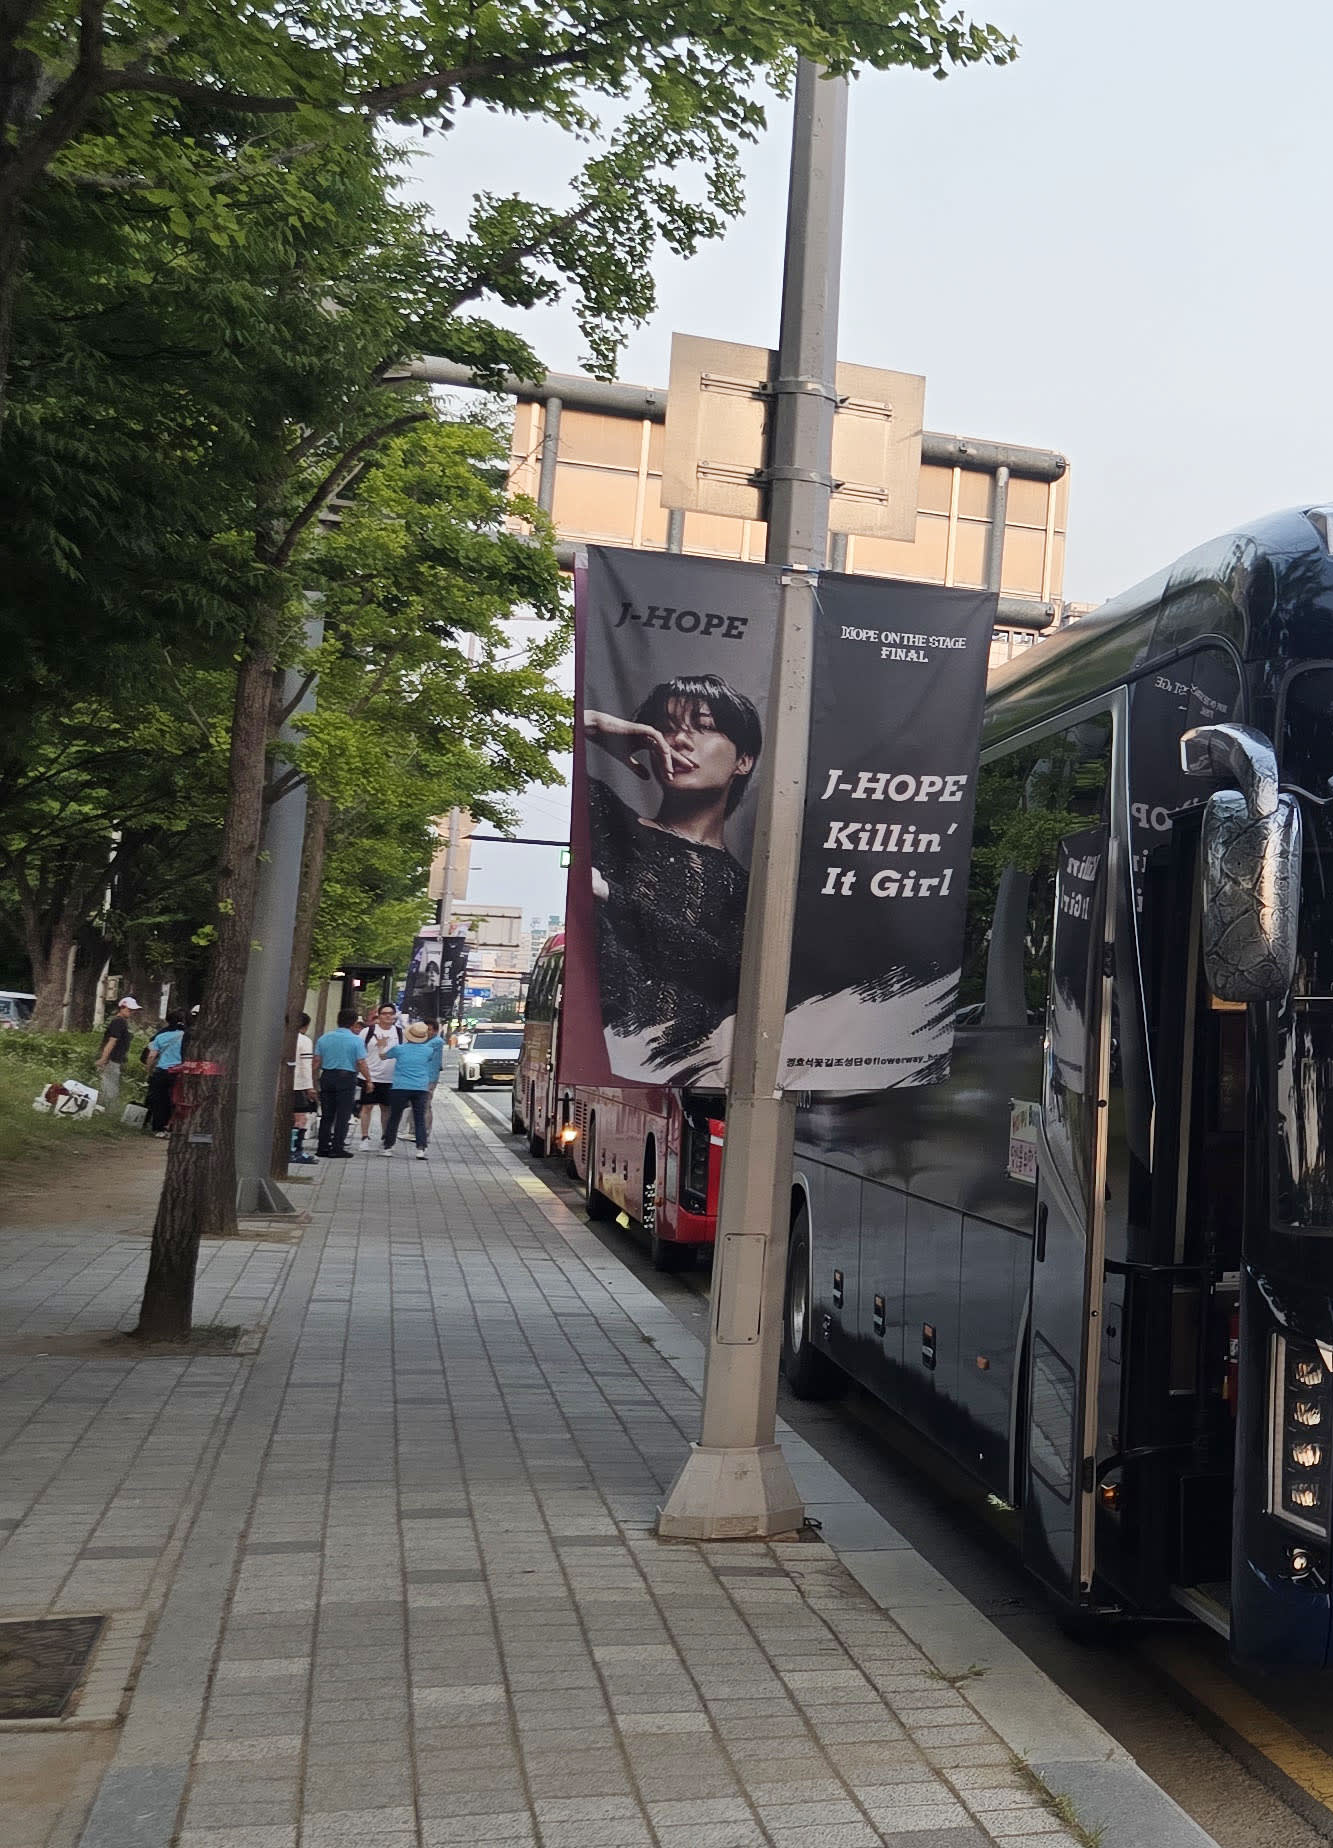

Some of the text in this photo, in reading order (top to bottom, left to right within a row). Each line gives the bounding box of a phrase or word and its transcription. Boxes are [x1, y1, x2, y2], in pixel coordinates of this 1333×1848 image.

[614, 601, 749, 640] J-HOPE
[880, 631, 900, 645] ON
[901, 633, 927, 647] THE
[928, 635, 967, 649] STAGE
[880, 646, 929, 663] FINAL
[820, 768, 968, 802] J-HOPE
[823, 821, 958, 853] Killin'
[820, 867, 953, 898] It Girl
